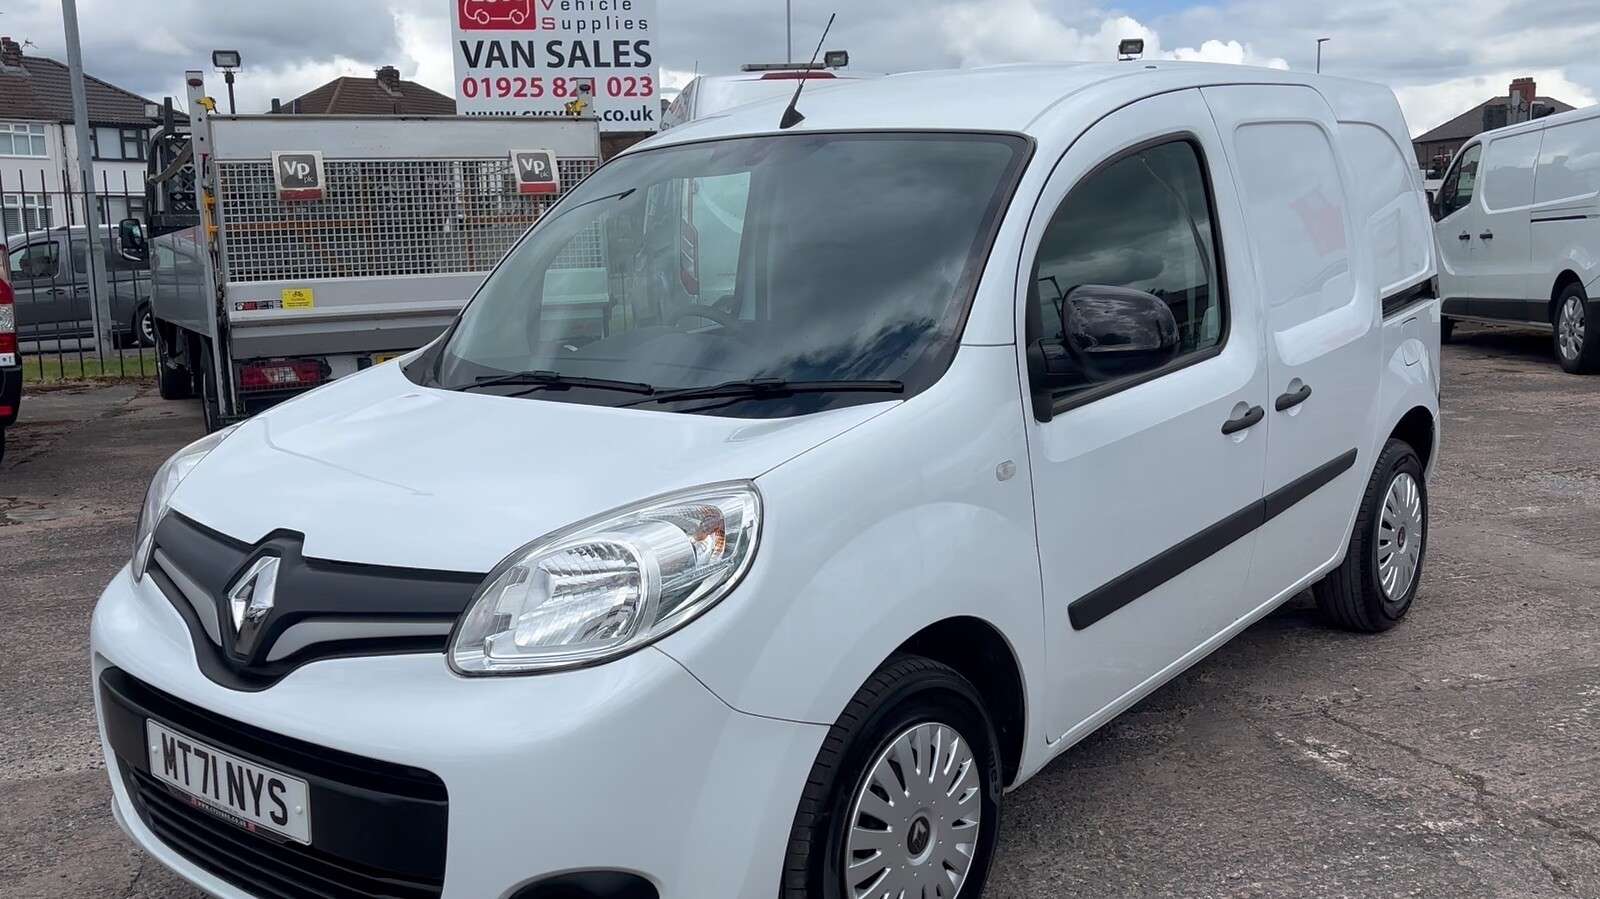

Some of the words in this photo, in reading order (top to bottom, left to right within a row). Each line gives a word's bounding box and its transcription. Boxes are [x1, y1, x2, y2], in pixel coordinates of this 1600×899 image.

[541, 0, 632, 11] Vehicle
[541, 16, 648, 34] Supplies
[460, 40, 535, 68] VAN
[546, 40, 652, 68] SALES
[463, 77, 544, 98] 01925
[607, 76, 653, 97] 023
[283, 160, 310, 179] Vp
[521, 158, 545, 175] Vp
[225, 760, 288, 826] NYS
